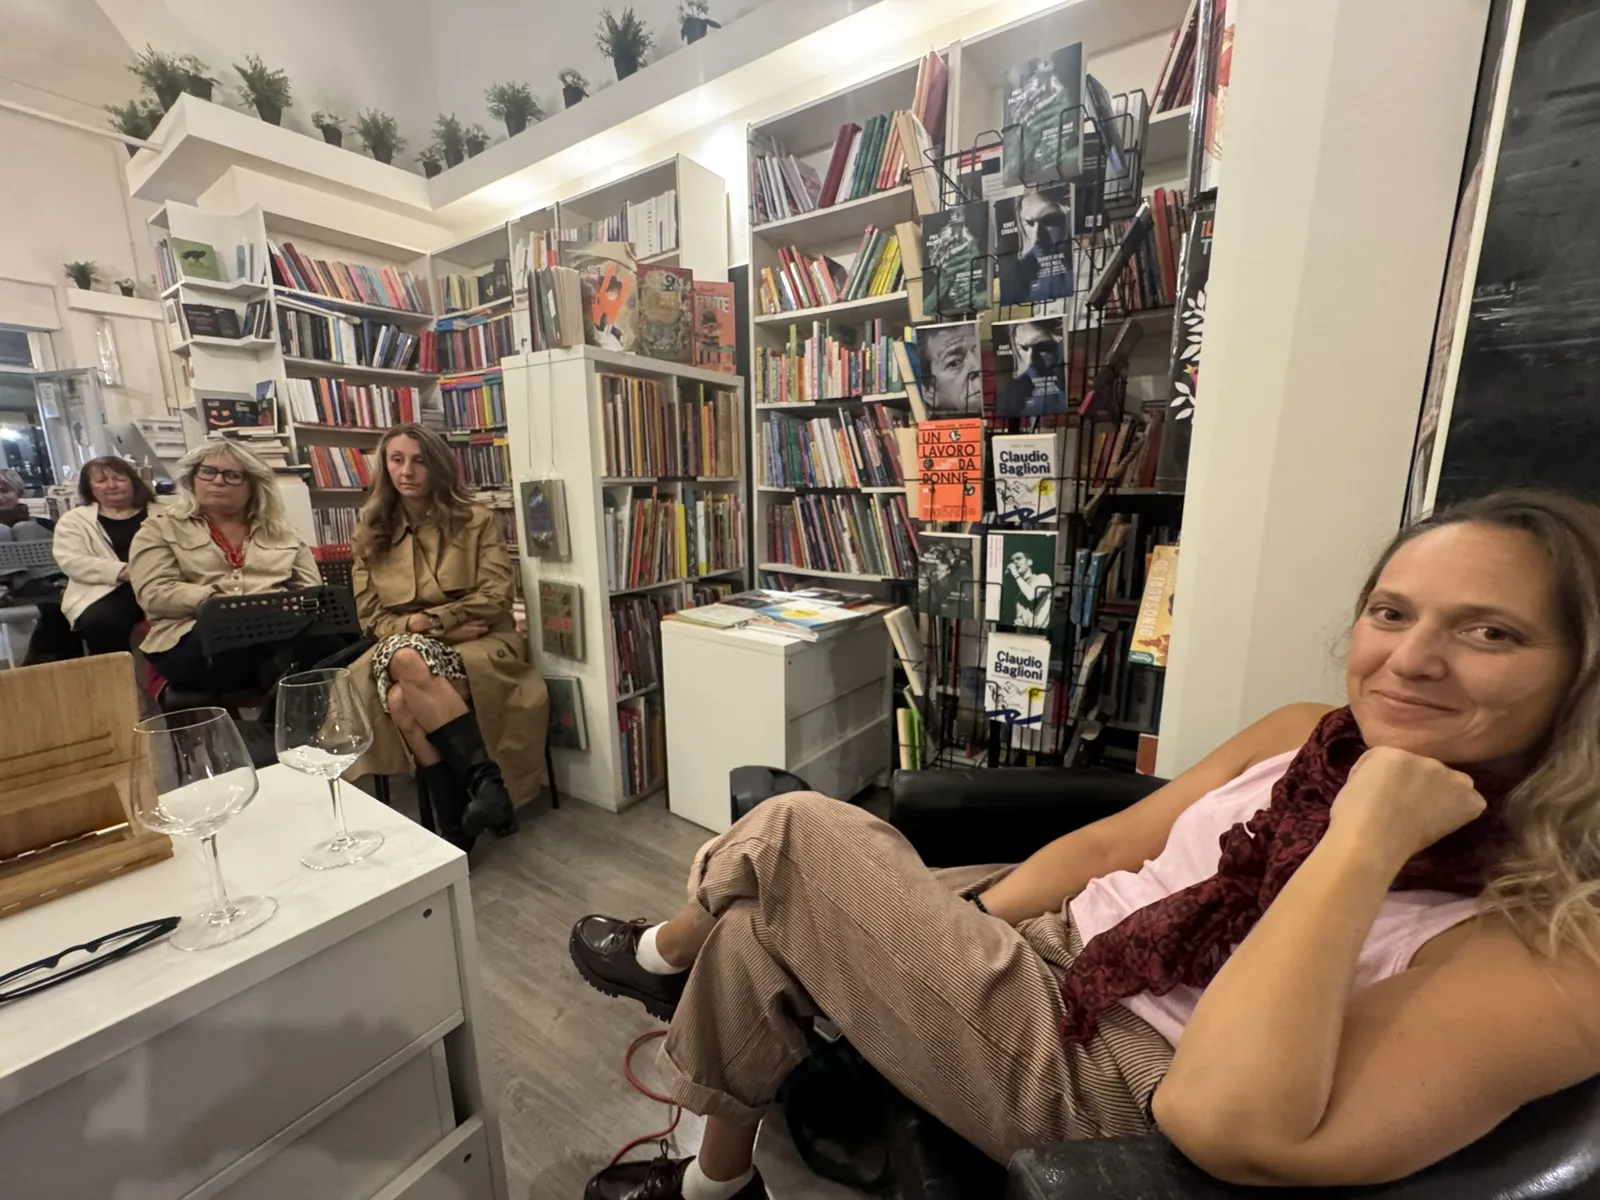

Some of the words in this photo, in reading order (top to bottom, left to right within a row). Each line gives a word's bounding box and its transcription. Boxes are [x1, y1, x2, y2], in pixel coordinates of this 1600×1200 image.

[922, 432, 941, 444] UN
[922, 444, 976, 457] LAVORO
[999, 450, 1049, 463] Claudio
[958, 458, 976, 470] DA
[999, 462, 1051, 477] Baglioni
[922, 472, 969, 485] DONNE
[1139, 577, 1166, 636] DINOSAURI
[996, 650, 1043, 669] Claudio
[994, 661, 1043, 681] Baglioni
